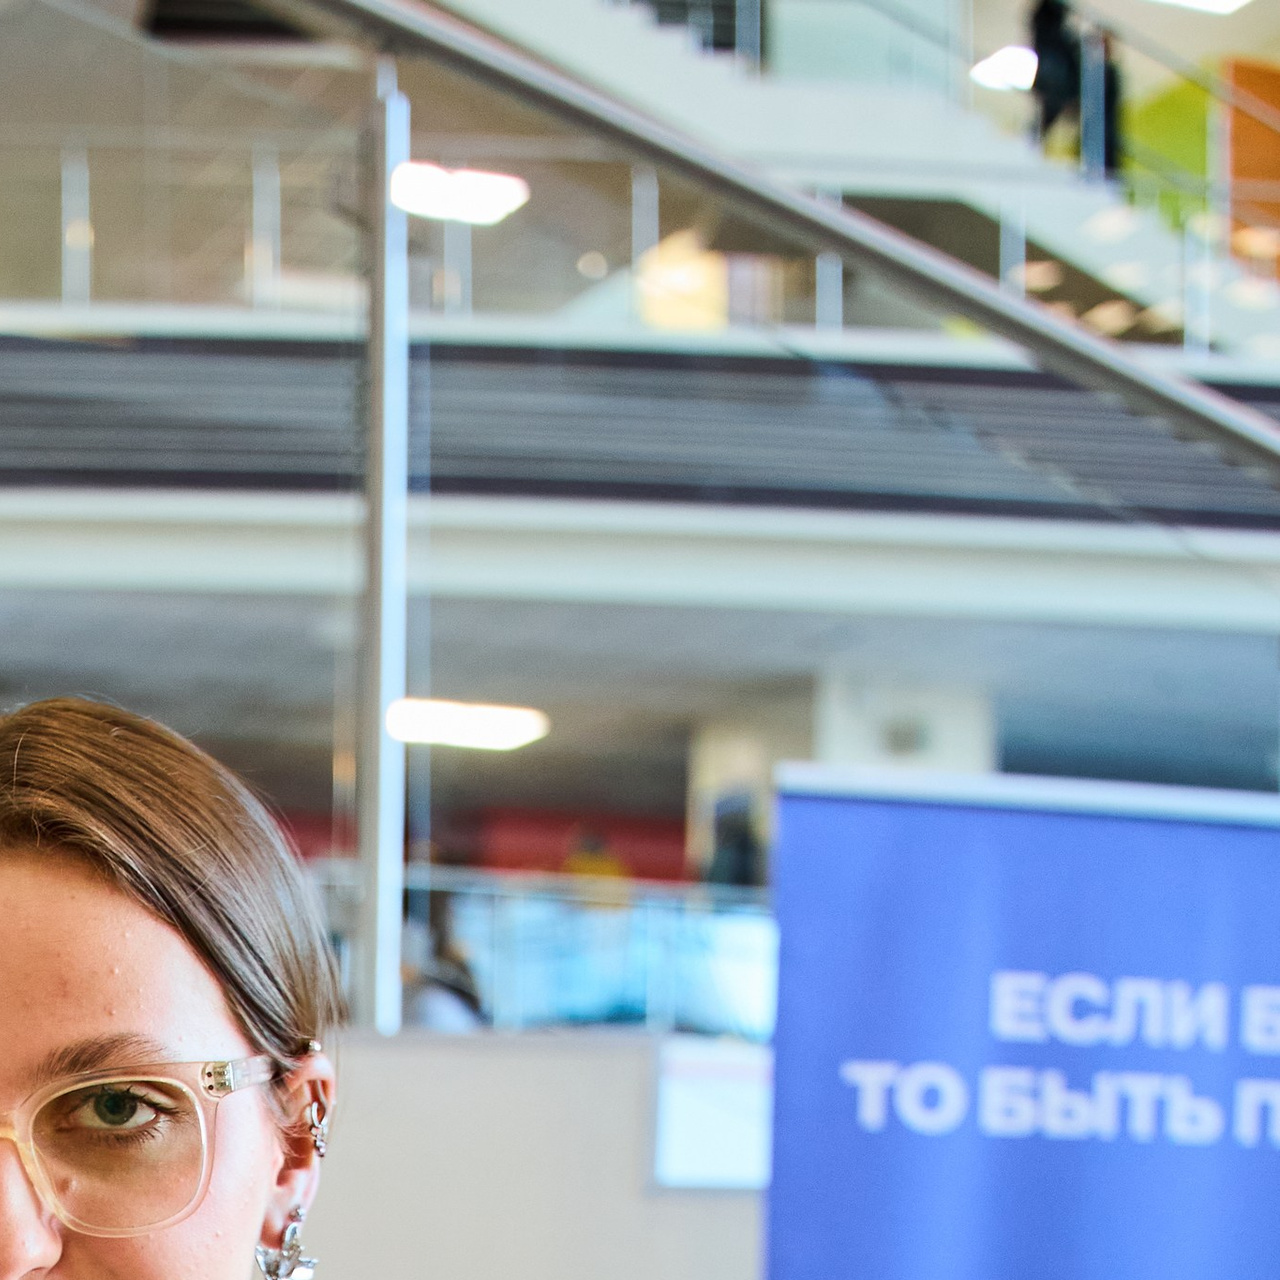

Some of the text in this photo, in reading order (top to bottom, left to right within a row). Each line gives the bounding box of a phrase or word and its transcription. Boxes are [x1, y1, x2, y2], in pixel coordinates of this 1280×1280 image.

[989, 971, 1229, 1053] ЕСЛИ
[841, 1059, 969, 1134] ТО
[979, 1064, 1225, 1147] БЫТЬ
